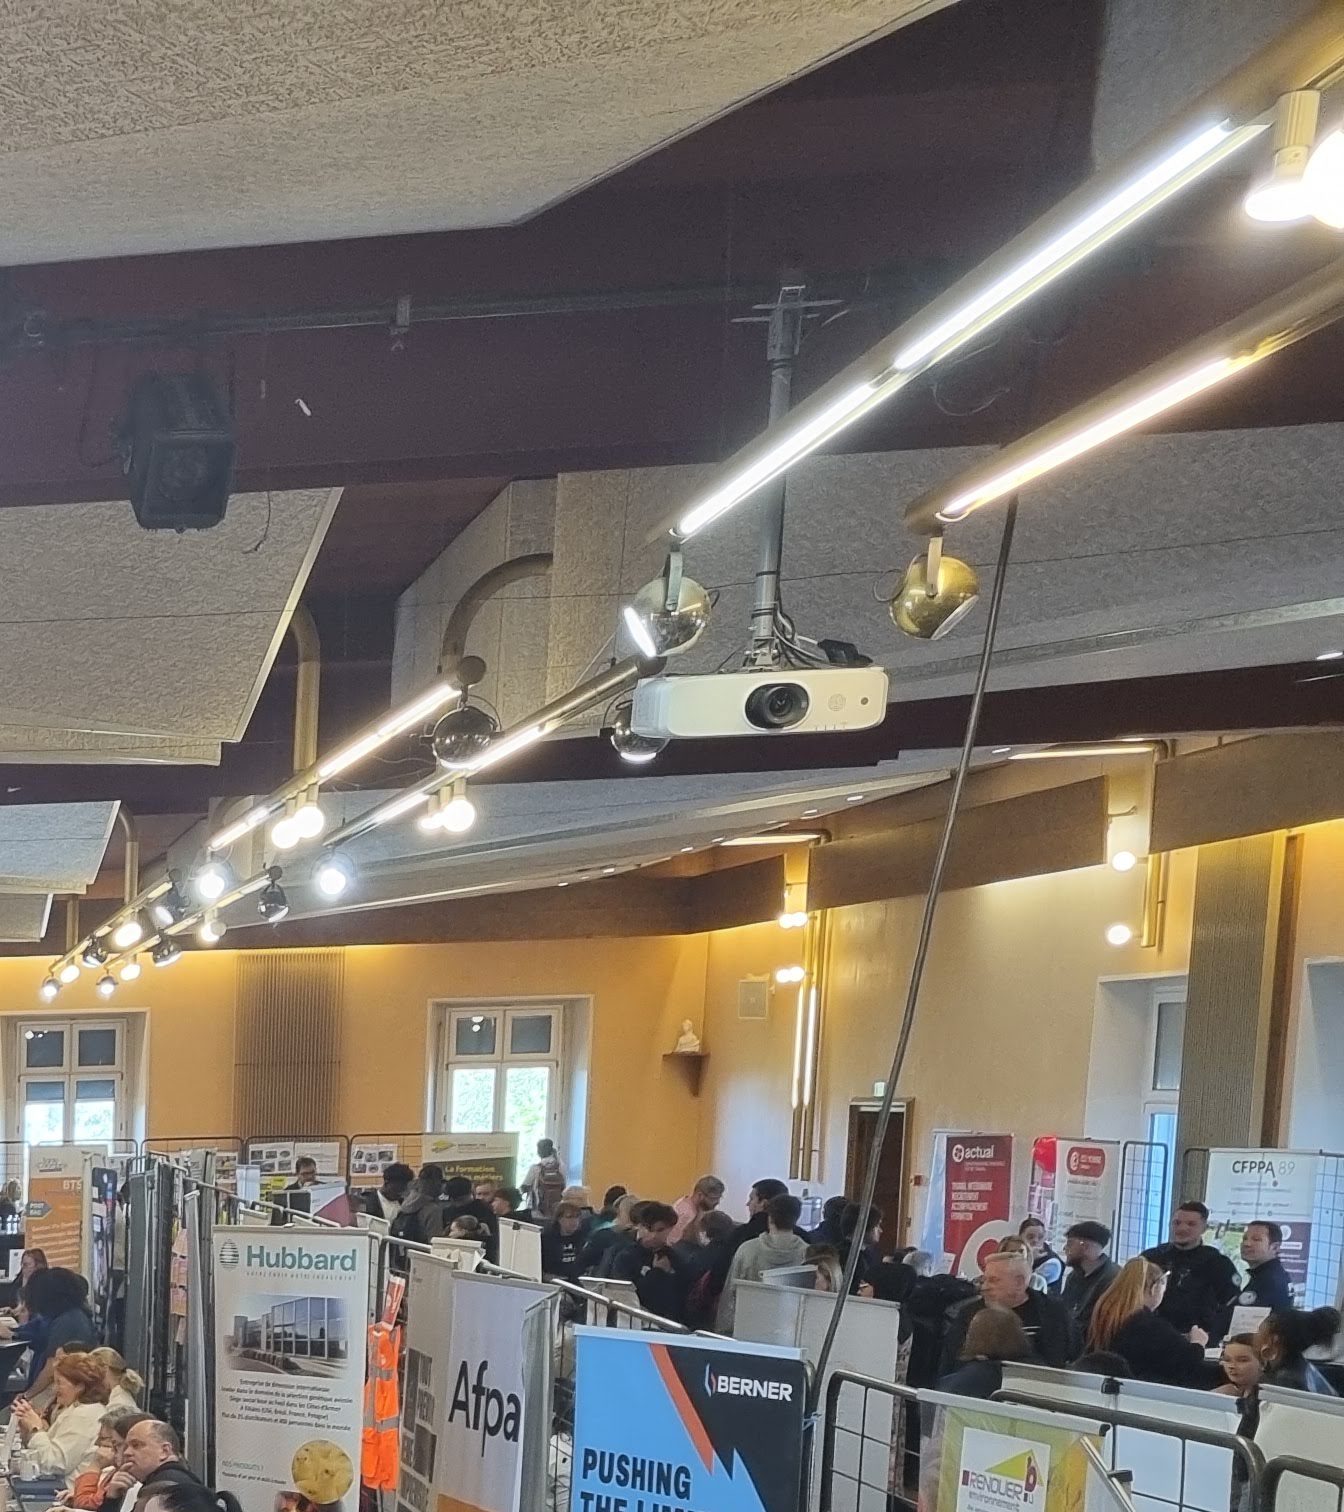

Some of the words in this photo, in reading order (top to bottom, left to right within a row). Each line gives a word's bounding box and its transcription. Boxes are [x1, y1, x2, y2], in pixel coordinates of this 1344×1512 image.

[965, 1145, 994, 1159] actual
[1232, 1161, 1275, 1178] CFPPA
[1278, 1161, 1296, 1175] 89
[246, 1245, 357, 1272] Hubbard
[717, 1375, 793, 1402] BERNER
[448, 1360, 521, 1458] Afpa
[582, 1448, 691, 1501] PUSHING
